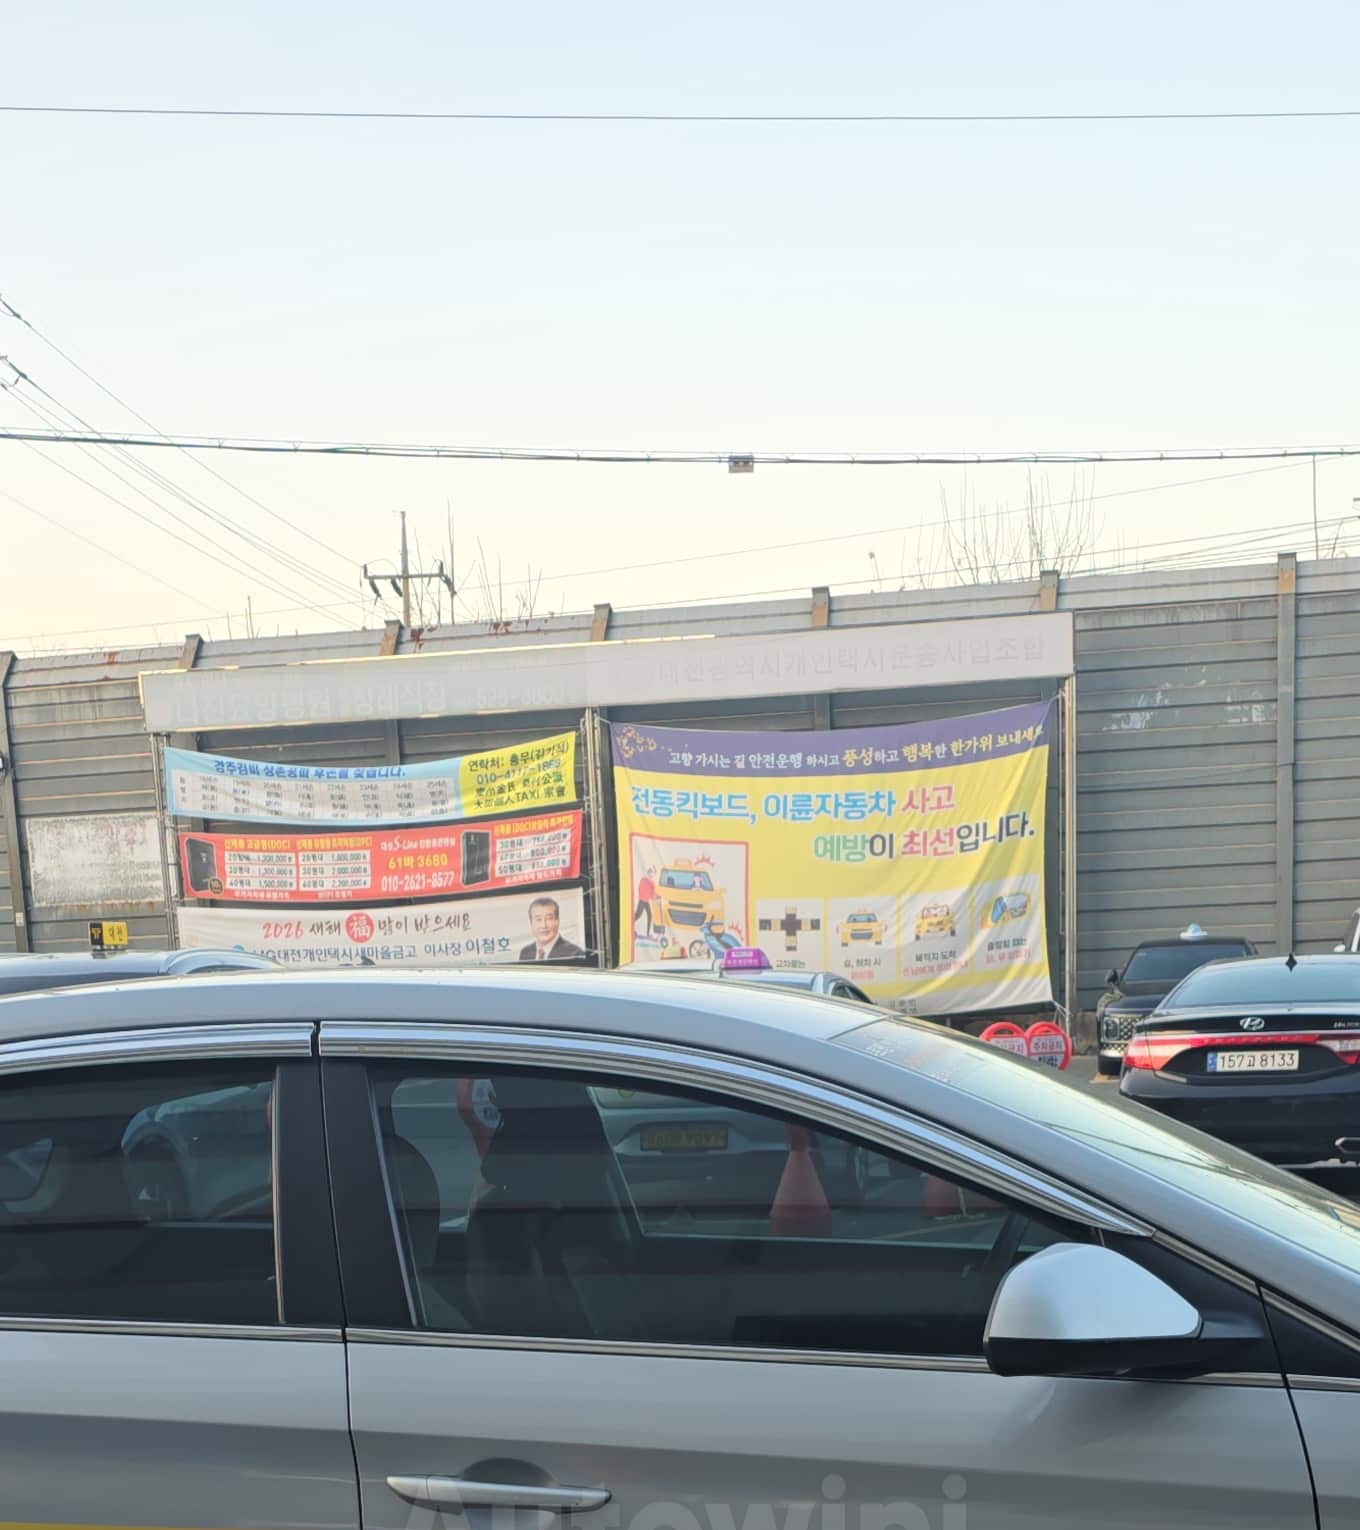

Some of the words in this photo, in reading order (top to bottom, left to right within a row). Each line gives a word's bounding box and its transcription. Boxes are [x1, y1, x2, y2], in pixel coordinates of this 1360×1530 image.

[669, 752, 693, 767] 고향
[695, 753, 731, 769] 가시는
[748, 752, 802, 769] 안전운행
[806, 754, 840, 767] 하시고
[842, 747, 899, 768] 풍성하고
[902, 742, 948, 763] 행복한
[950, 734, 993, 757] 한가위
[631, 786, 757, 825] 전동킥보드,
[764, 789, 897, 821] 이륜자동차
[901, 785, 956, 813] 사고
[813, 831, 894, 863] 예방이
[901, 811, 1035, 857] 최선입니다.
[417, 854, 448, 868] 3680
[263, 921, 304, 940] 2026
[309, 920, 341, 937] 새해
[424, 942, 461, 958] 이사장
[466, 936, 511, 956] 이철호
[1259, 1052, 1295, 1068] 8133
